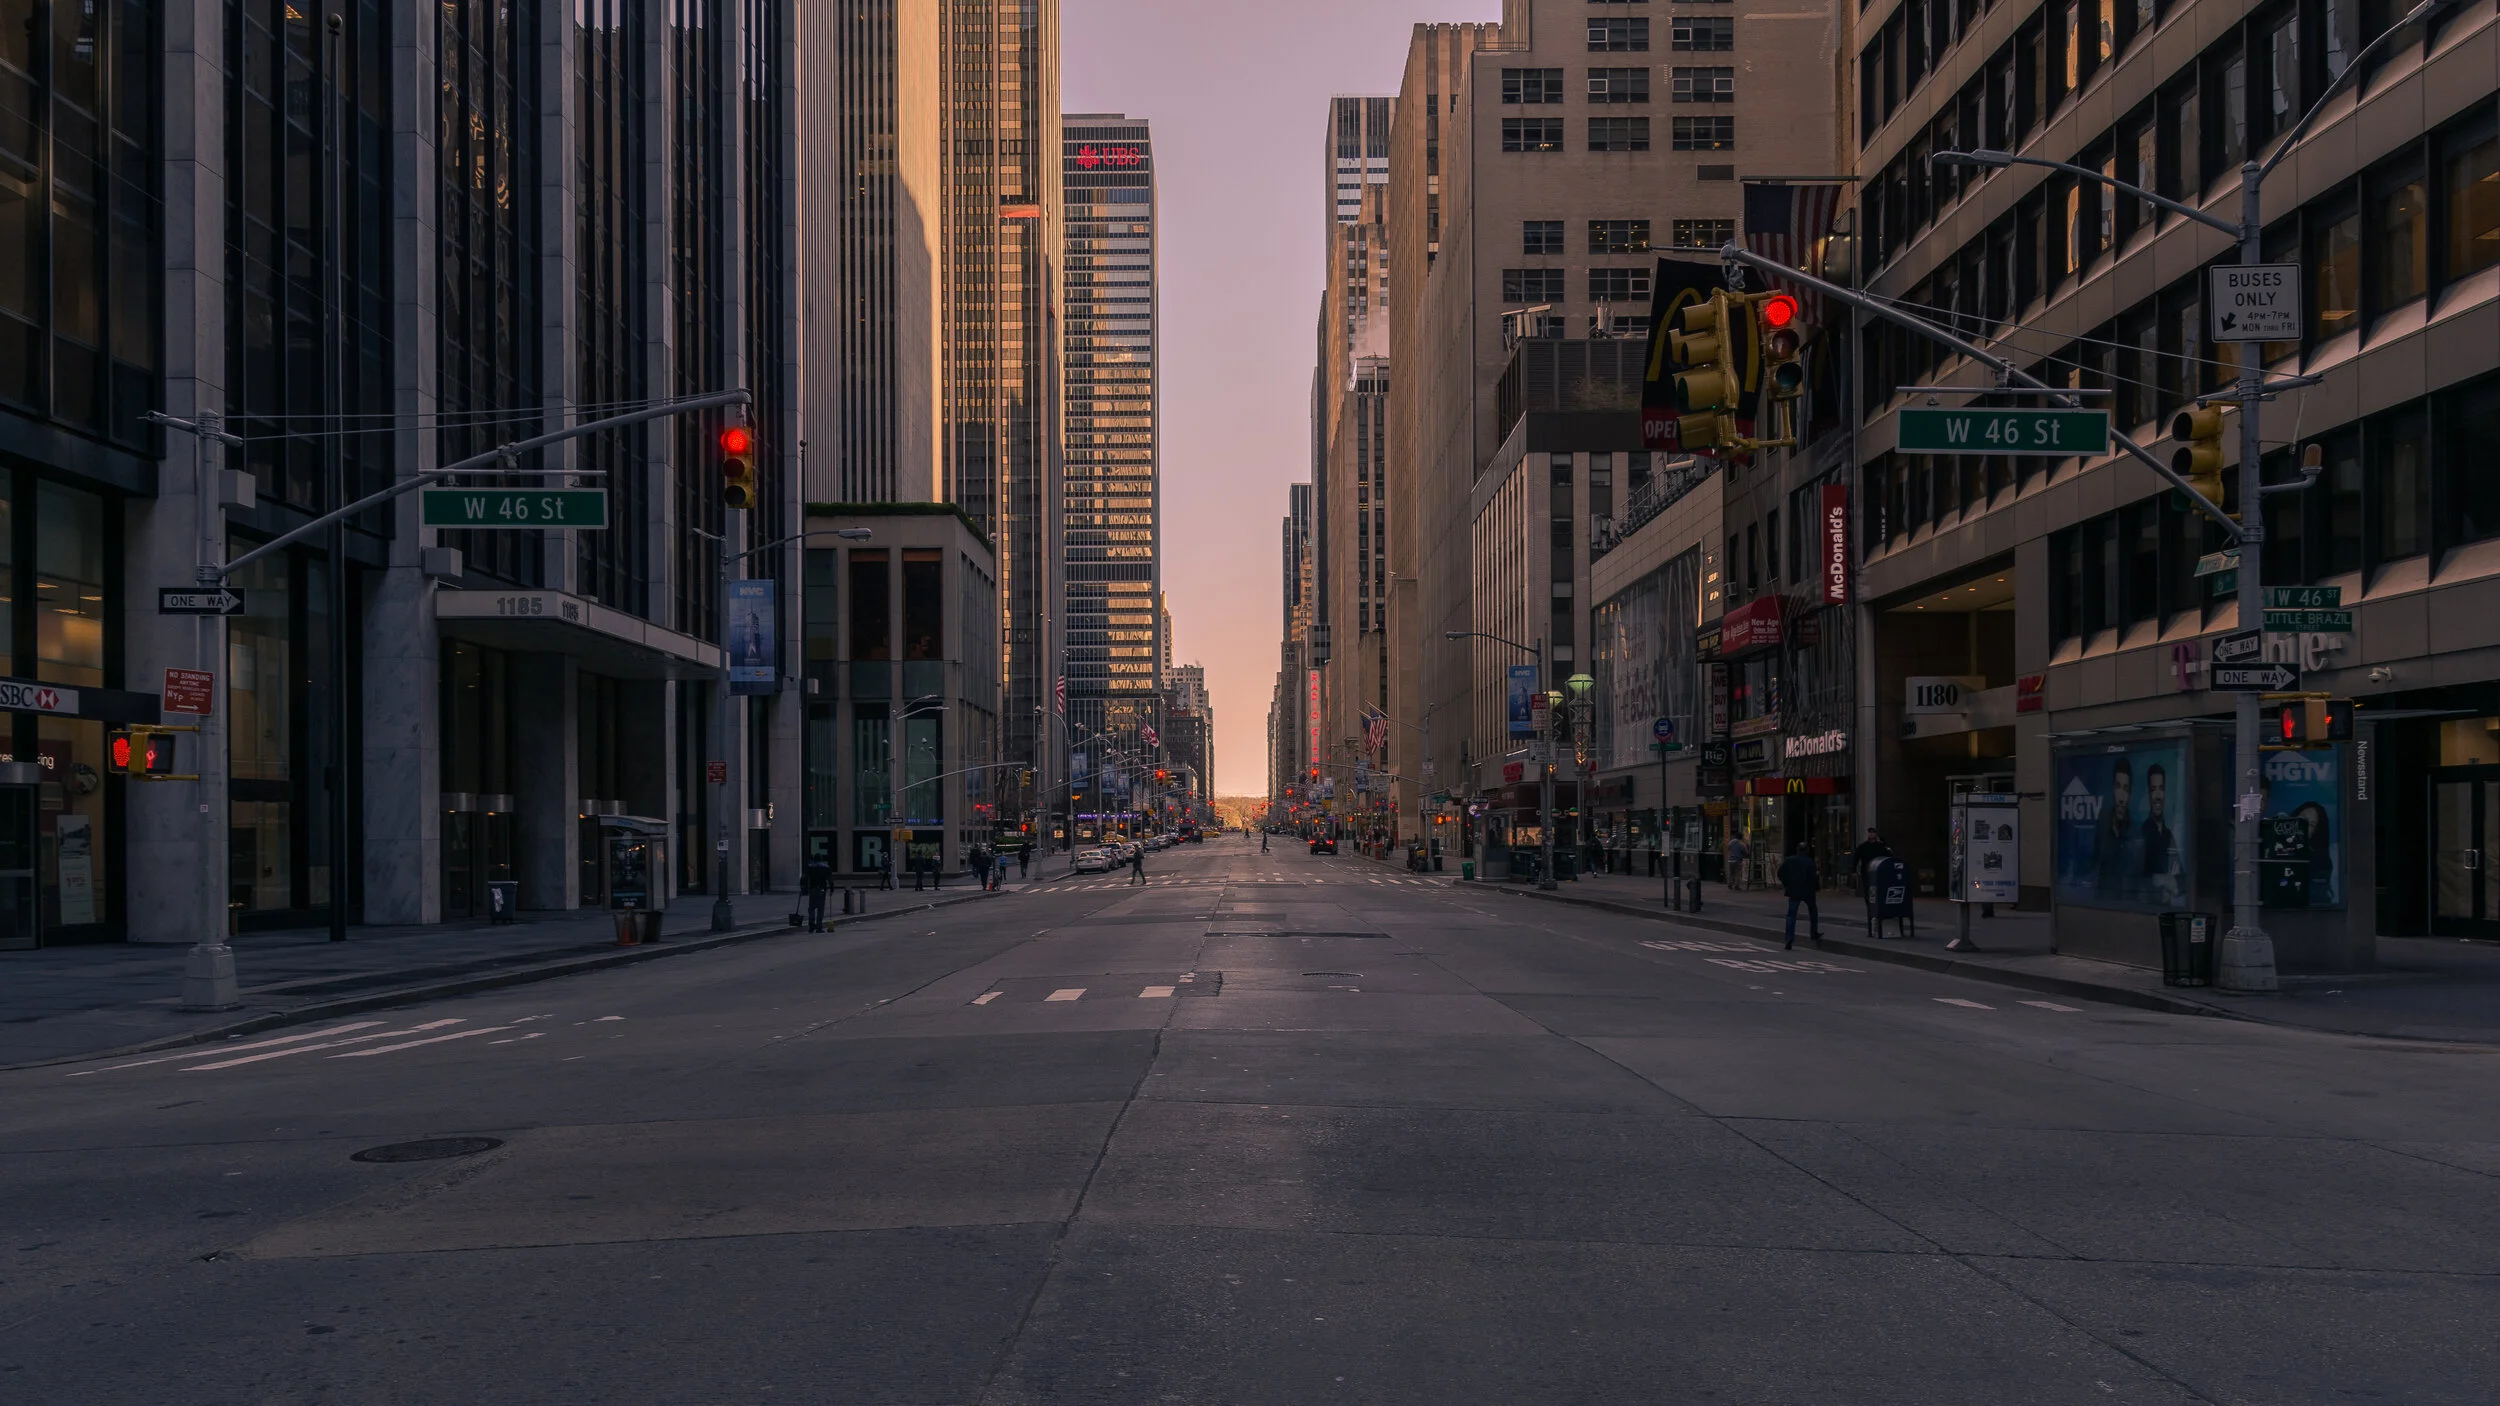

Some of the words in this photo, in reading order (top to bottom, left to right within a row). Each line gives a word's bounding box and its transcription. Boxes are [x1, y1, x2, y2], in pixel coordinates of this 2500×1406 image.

[1102, 147, 1140, 166] UBS
[2229, 272, 2282, 288] BUSES
[2235, 291, 2277, 307] ONLY
[2247, 310, 2290, 321] 4PM-7PM
[2241, 323, 2260, 332] MON
[2281, 322, 2296, 331] FRI
[1945, 417, 1971, 444] W
[1984, 417, 2020, 445] 46
[2033, 418, 2061, 445] St
[463, 496, 486, 520] W
[498, 496, 529, 520] 46
[540, 496, 565, 520] St
[1829, 506, 1845, 600] McDonald's
[170, 595, 195, 607] ONE
[206, 595, 232, 607] WAY
[496, 597, 543, 615] 1185
[2277, 589, 2291, 607] W
[2298, 590, 2322, 607] 46
[561, 600, 579, 621] 1185
[2264, 612, 2304, 625] LITTLE
[2307, 612, 2351, 625] BRAZIL
[1751, 618, 1765, 627] New
[2219, 643, 2233, 657] ONE
[2239, 640, 2256, 652] WAY
[169, 671, 179, 679] NO
[180, 672, 211, 681] STANDING
[1713, 675, 1726, 687] WE
[2223, 671, 2248, 683] ONE
[2261, 671, 2287, 683] WAY
[1311, 673, 1319, 720] RADIO
[1714, 694, 1727, 706] BUY
[1916, 684, 1958, 707] 1180
[1311, 727, 1319, 763] CITY
[1785, 729, 1846, 759] McDonald's
[2264, 761, 2332, 781] HGTV
[2356, 740, 2368, 801] Newsstand
[2060, 795, 2104, 821] HGTV
